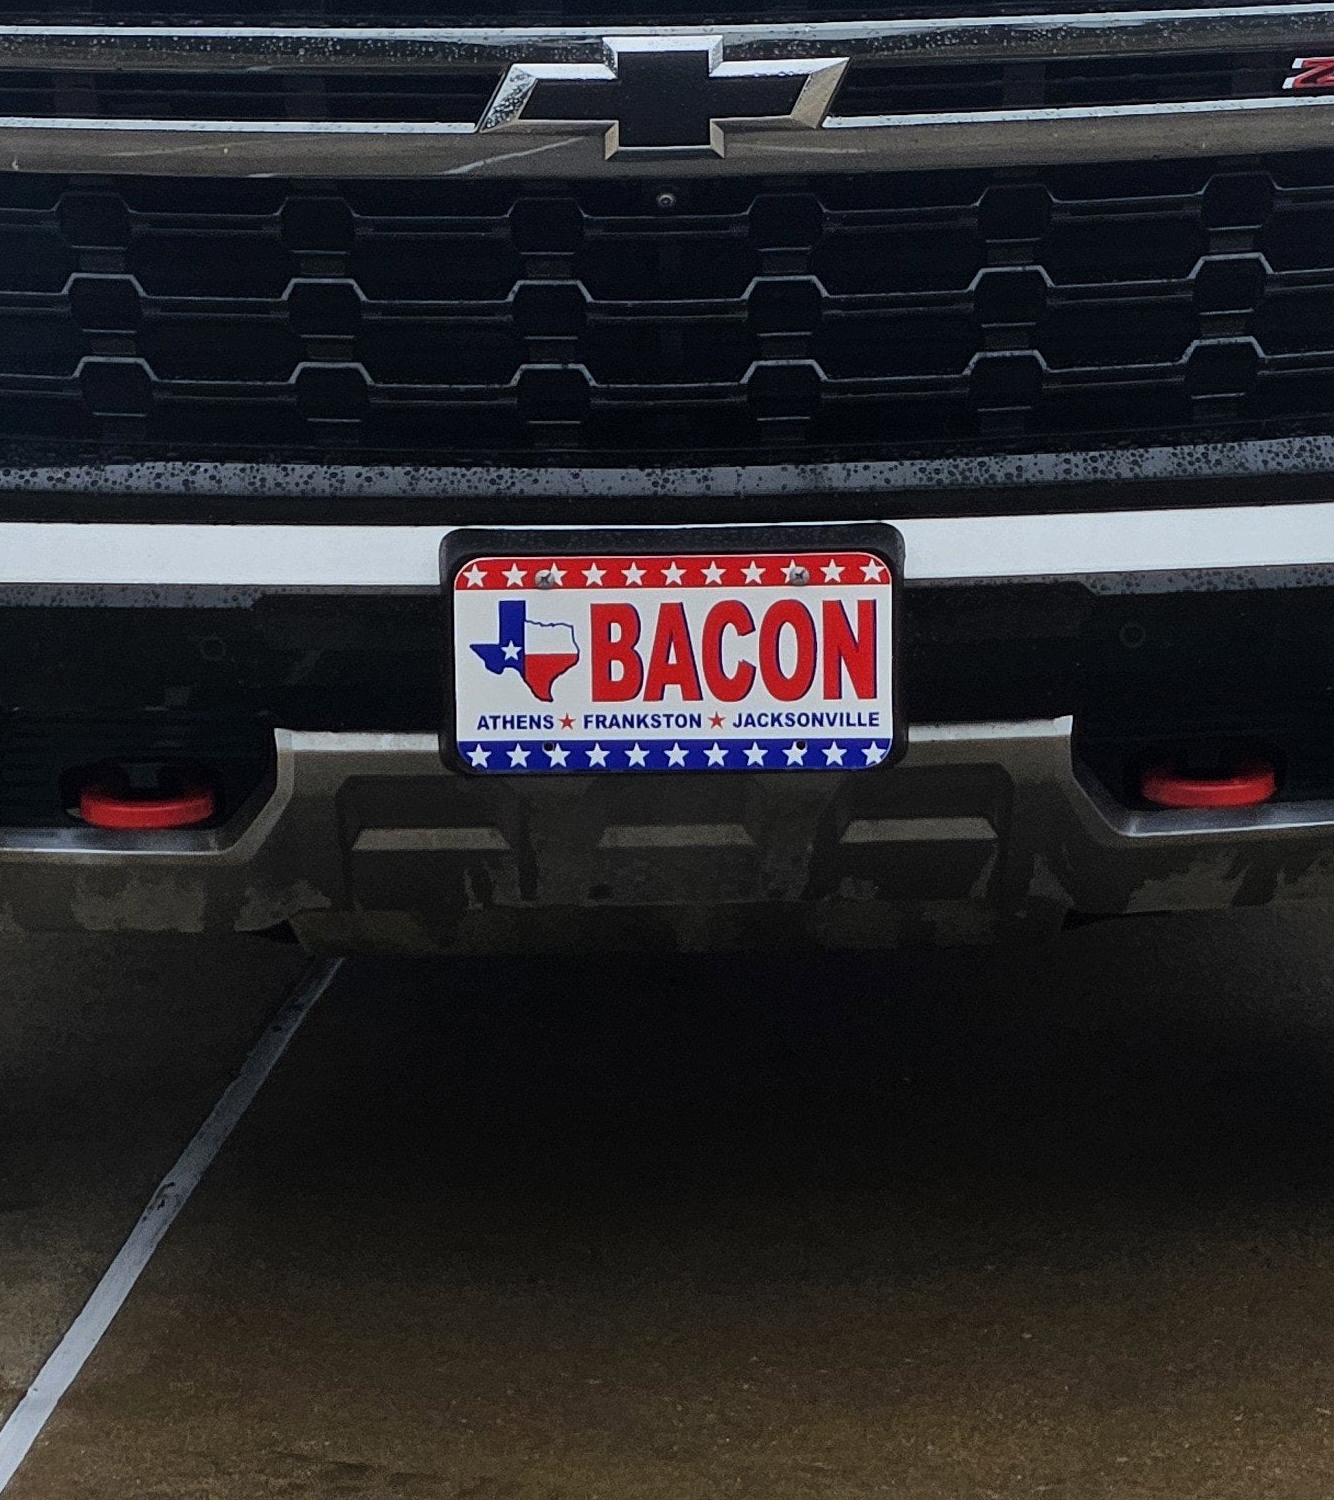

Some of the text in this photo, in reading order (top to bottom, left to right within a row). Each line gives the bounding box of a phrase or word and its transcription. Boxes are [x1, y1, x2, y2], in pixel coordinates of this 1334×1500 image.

[590, 599, 878, 703] BACON
[476, 711, 880, 731] ATHENS FRANKSTON JACKSONVILLE
